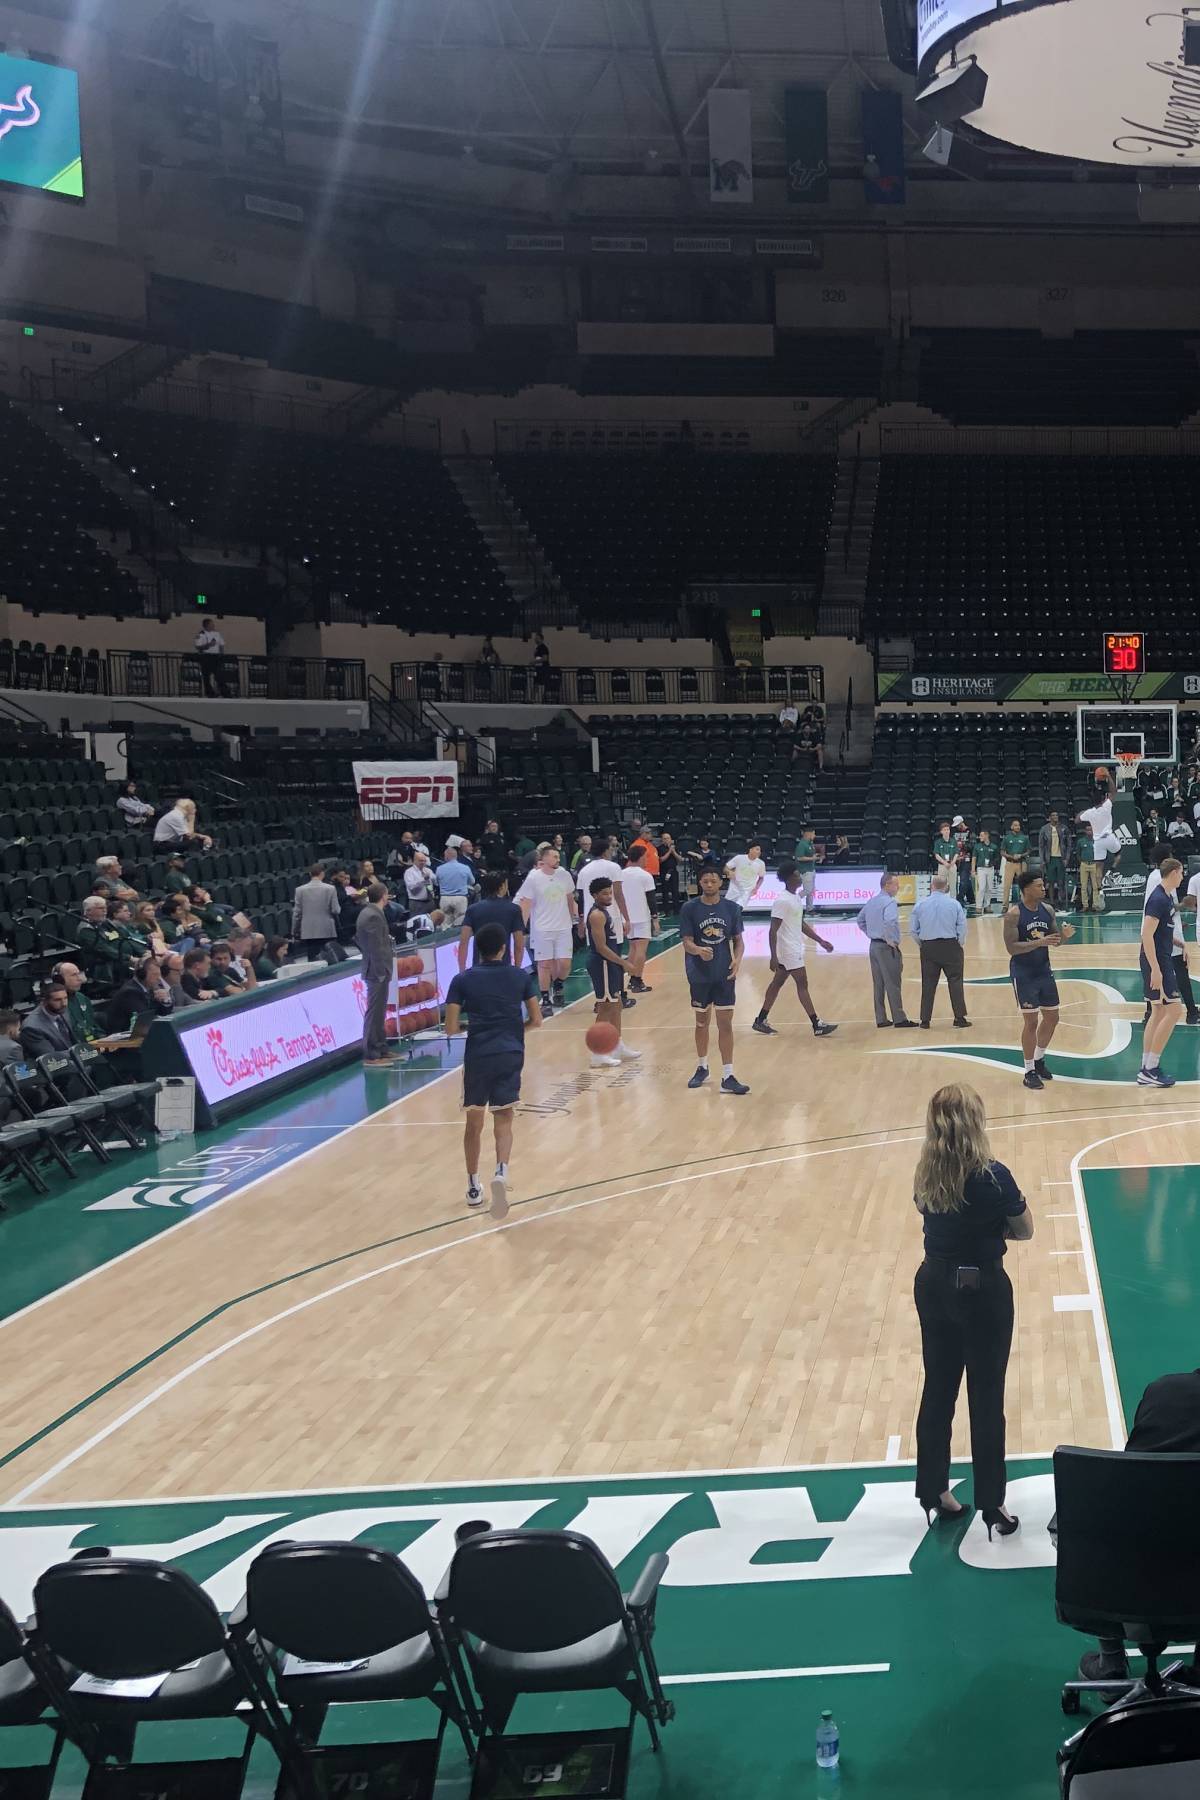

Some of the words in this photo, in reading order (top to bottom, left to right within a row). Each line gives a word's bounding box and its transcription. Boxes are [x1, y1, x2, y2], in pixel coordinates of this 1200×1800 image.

[1108, 637, 1140, 649] 21:40
[1112, 650, 1136, 670] 30
[932, 678, 993, 688] HERITAGE
[932, 688, 993, 696] INSURANCE
[360, 776, 454, 804] ESPN
[1119, 838, 1138, 846] das
[812, 889, 850, 901] Tampa
[853, 888, 875, 900] Bay
[277, 1033, 317, 1060] Tampa
[312, 1023, 337, 1047] Bay
